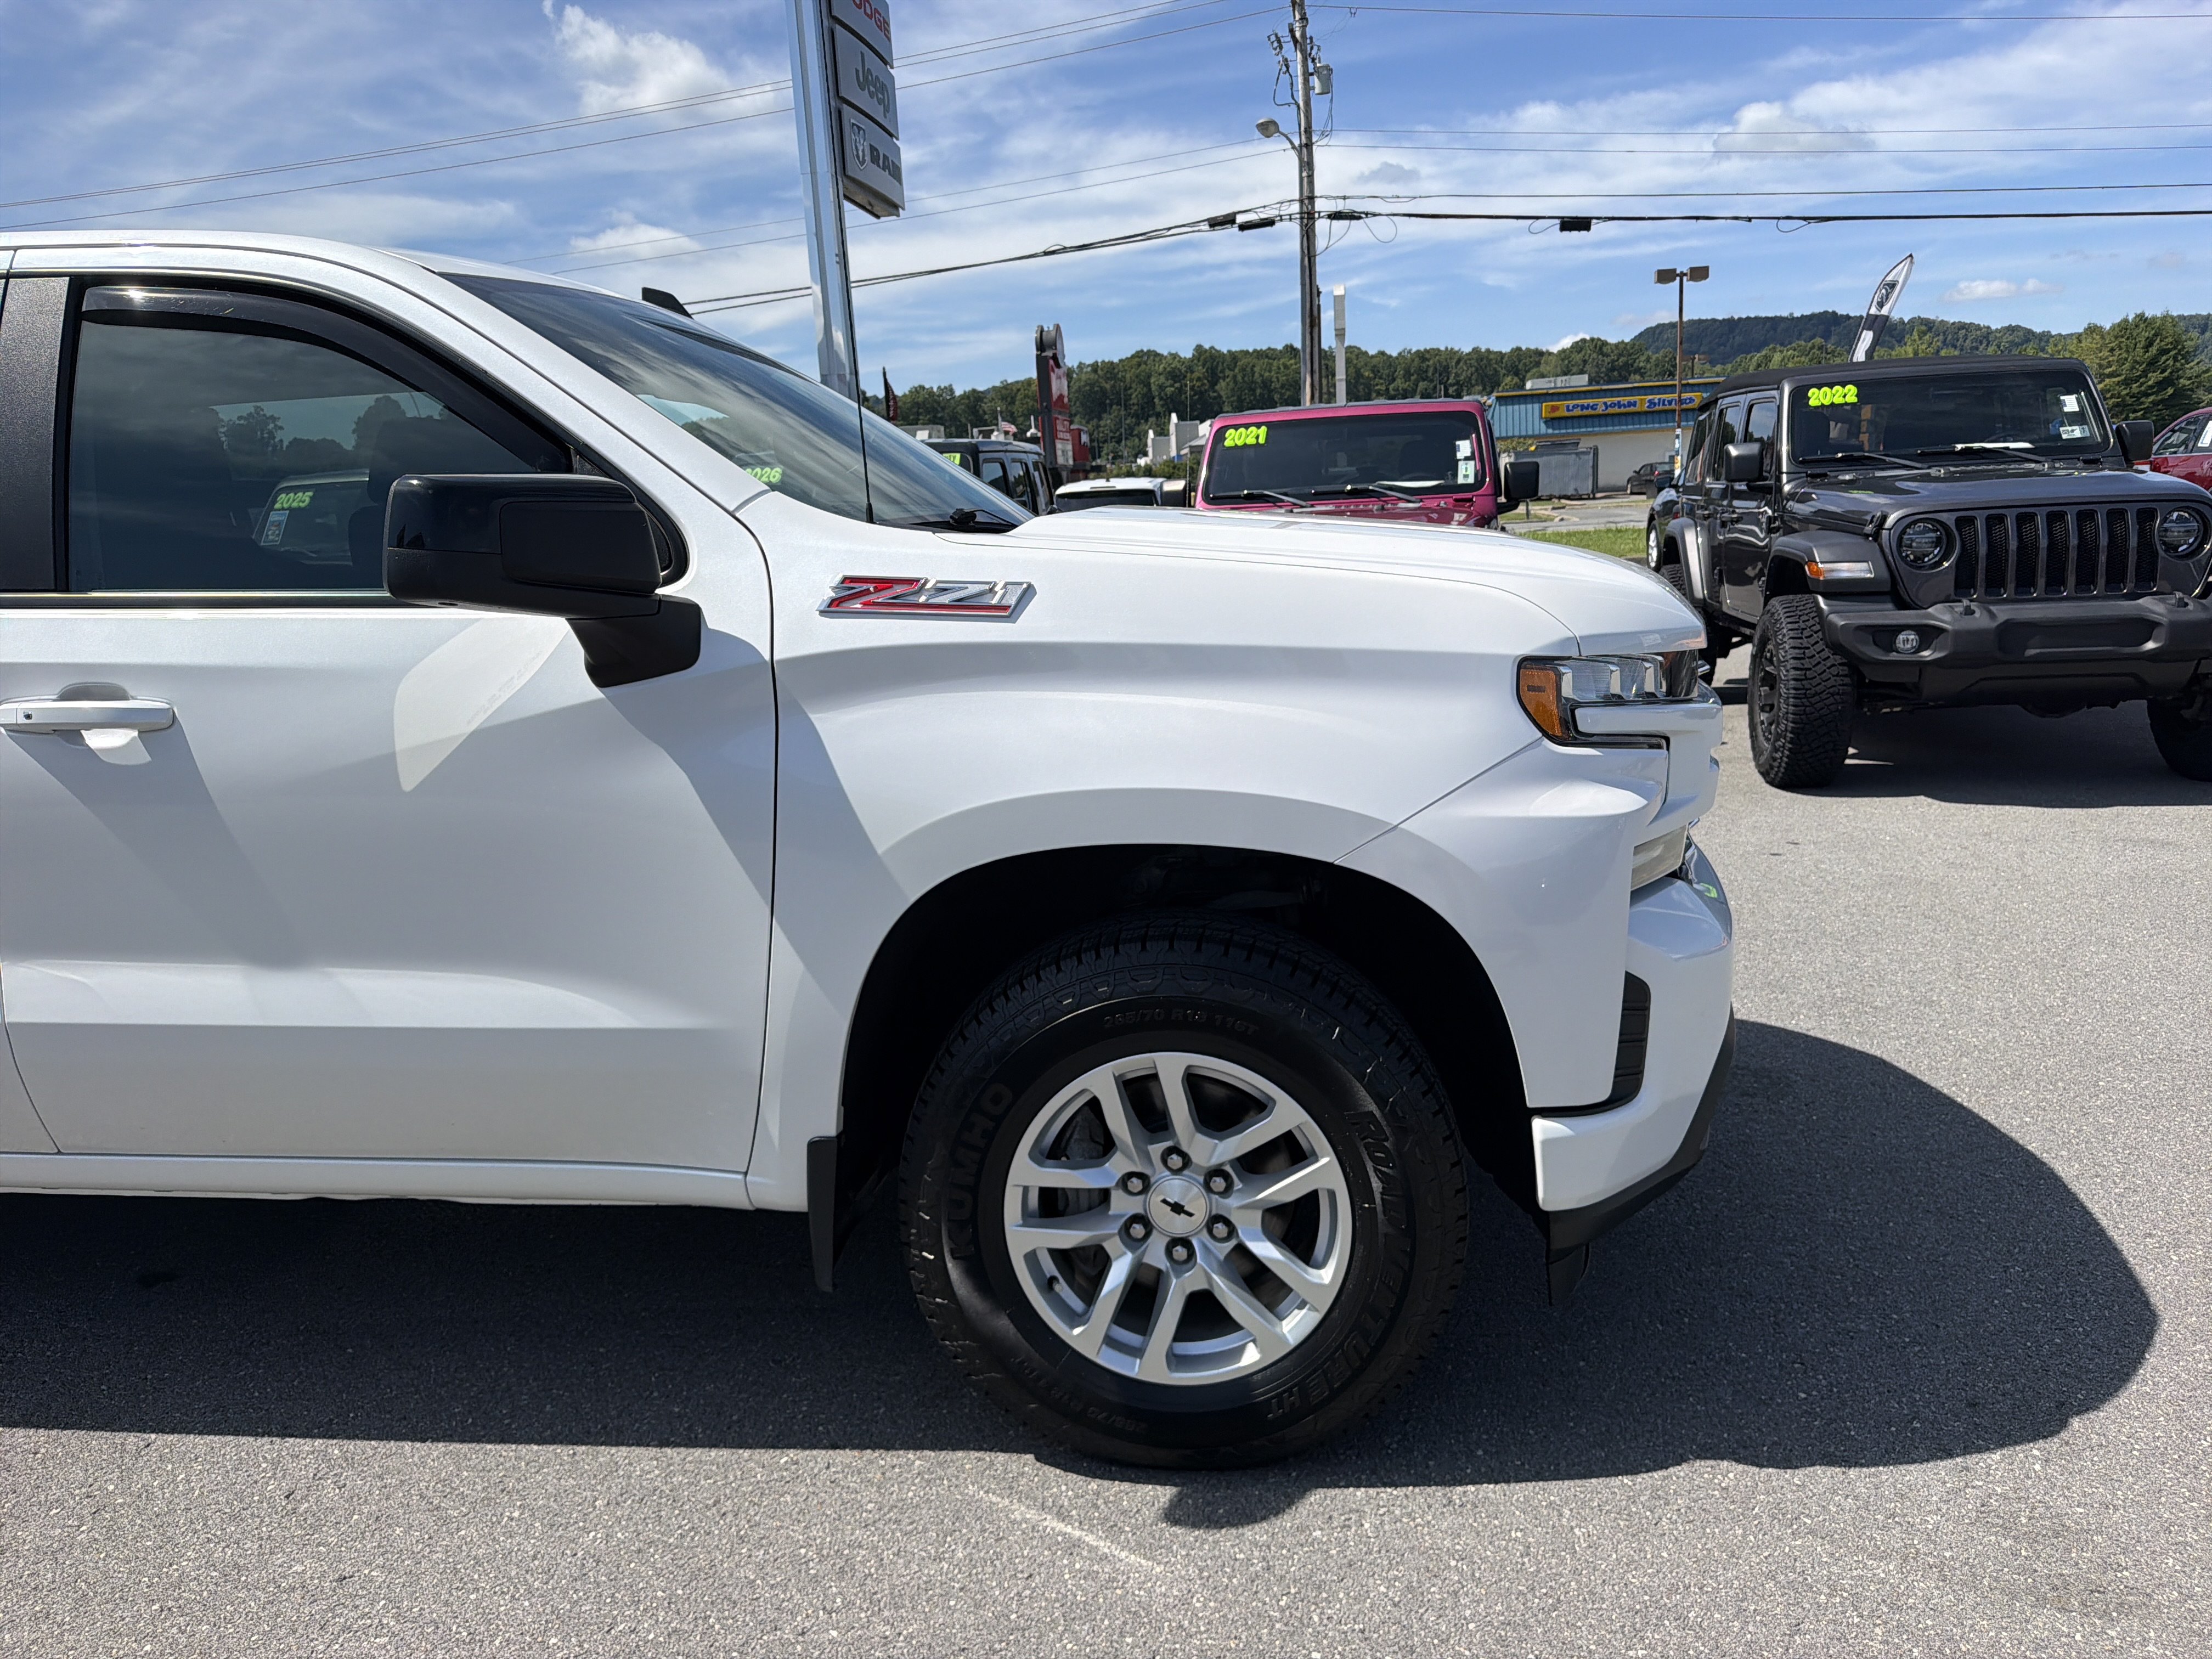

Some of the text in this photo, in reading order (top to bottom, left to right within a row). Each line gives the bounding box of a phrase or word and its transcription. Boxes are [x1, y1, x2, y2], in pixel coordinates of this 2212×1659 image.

[855, 50, 890, 119] Jeep
[1808, 384, 1858, 407] 2022
[1224, 425, 1267, 447] 2021
[274, 491, 314, 509] 2025
[816, 573, 1031, 618] Z71
[948, 1082, 1013, 1260] KUMHO
